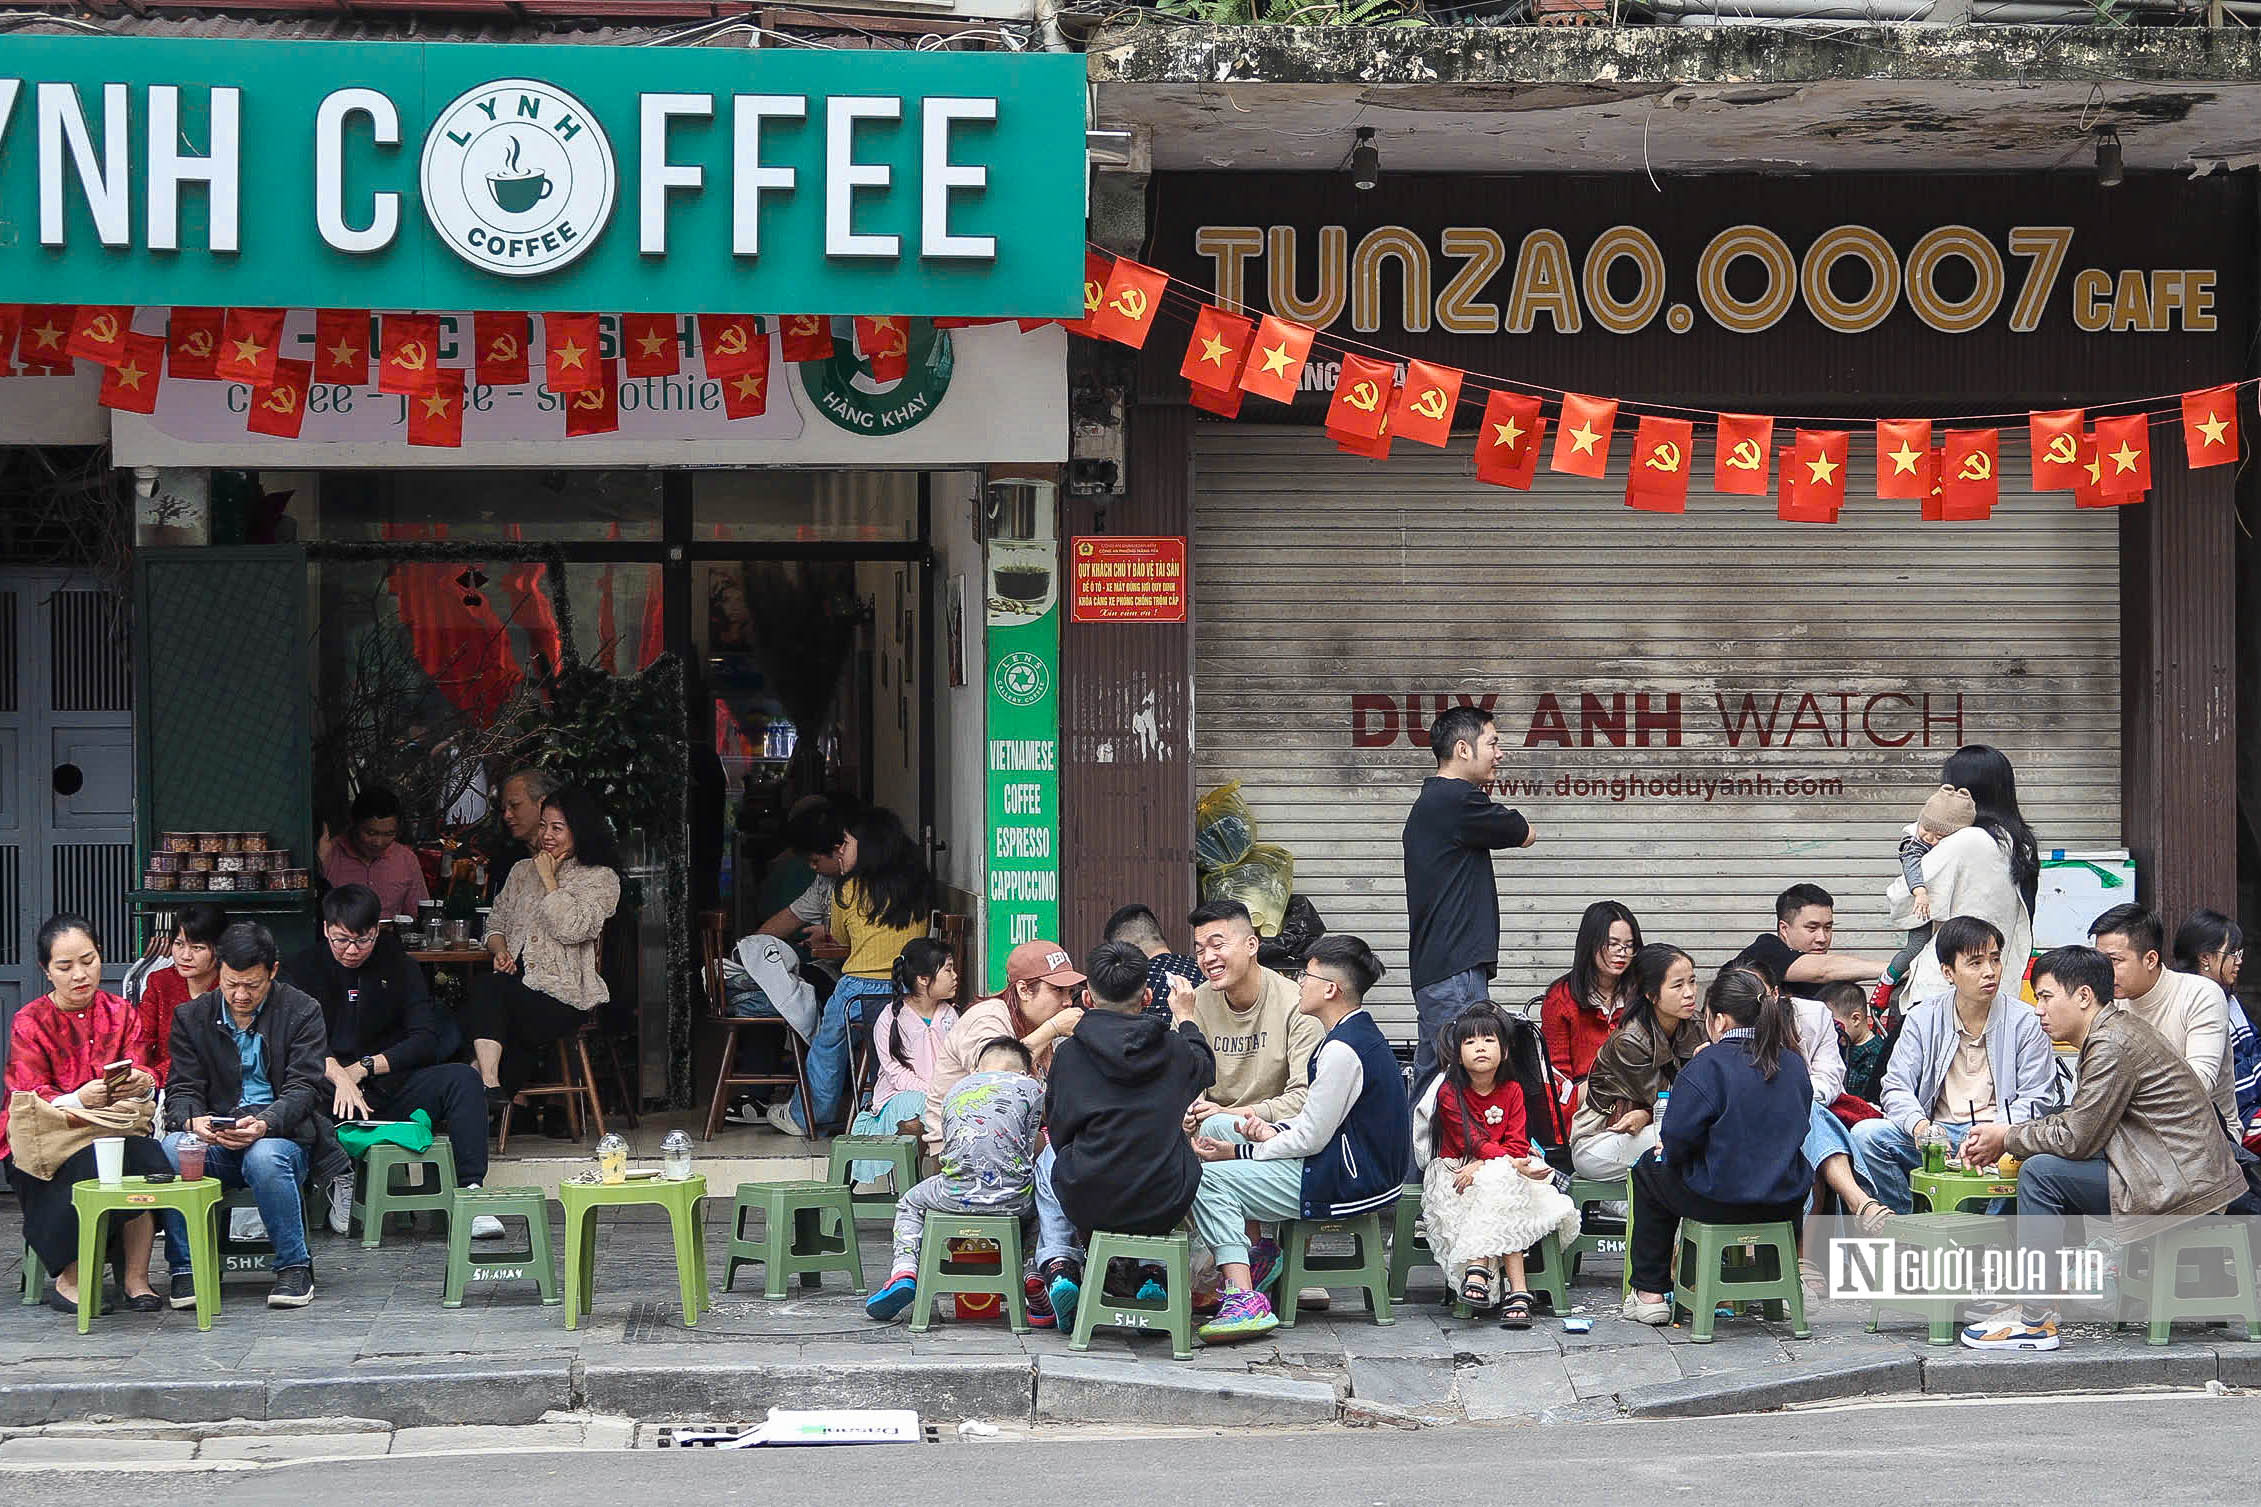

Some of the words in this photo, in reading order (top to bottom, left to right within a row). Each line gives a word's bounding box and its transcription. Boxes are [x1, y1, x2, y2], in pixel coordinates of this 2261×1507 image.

[446, 95, 581, 147] LYNH
[468, 220, 577, 257] COFFEE
[2073, 268, 2218, 332] CAFE
[823, 392, 875, 427] HÀNG
[881, 392, 929, 427] KHAY
[1078, 560, 1090, 579] QUÝ
[1091, 560, 1113, 577] KHÁCH
[1113, 560, 1126, 577] CHÚ
[1132, 558, 1145, 577] BẢO
[1155, 560, 1166, 577] TÀI
[1166, 557, 1180, 577] SẢN
[1106, 582, 1113, 592] XE
[1108, 596, 1116, 606] XE
[1002, 655, 1042, 670] LENS
[1523, 692, 1683, 748] ANH
[1715, 691, 1963, 748] WATCH
[990, 740, 1054, 771] VIETNAMESE
[1004, 784, 1041, 814] COFFEE
[996, 827, 1050, 858] ESPRESSO
[991, 870, 1056, 901] CAPPUCCINO
[1010, 914, 1038, 945] LATTE
